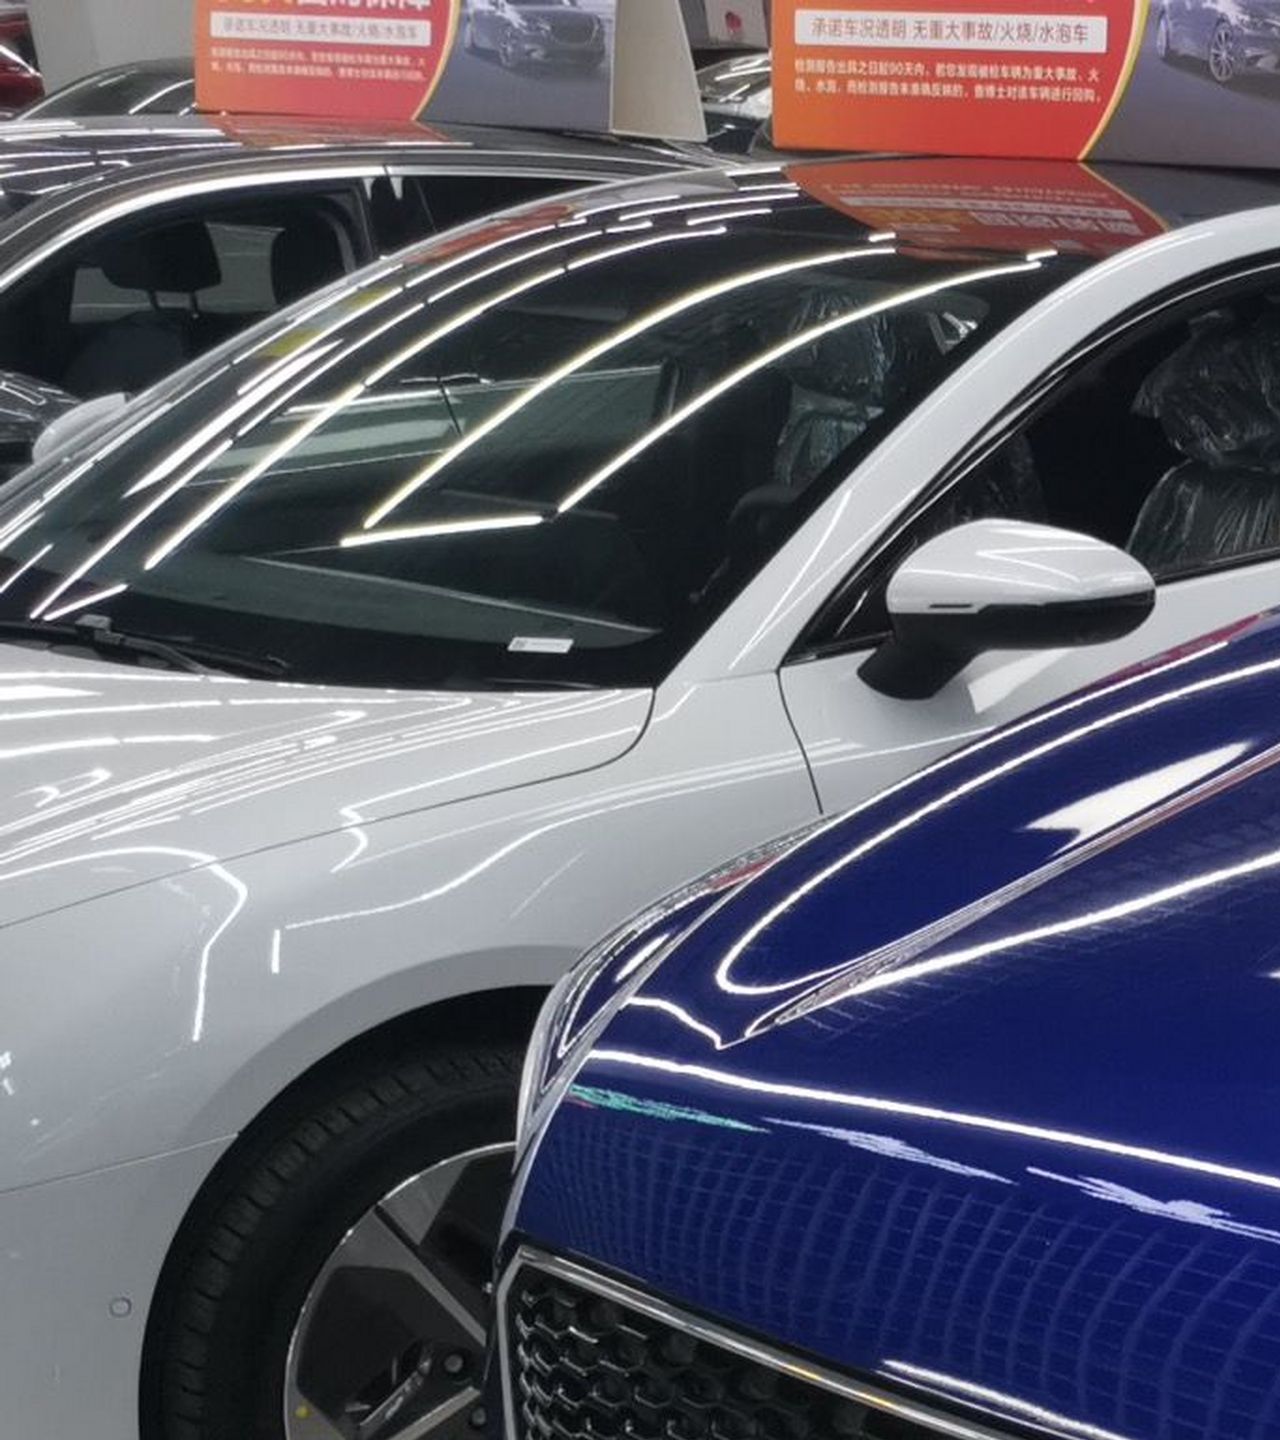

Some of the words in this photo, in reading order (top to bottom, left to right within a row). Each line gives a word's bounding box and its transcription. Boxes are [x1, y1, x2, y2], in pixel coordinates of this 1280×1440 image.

[810, 17, 907, 39] 承诺车况透明
[912, 19, 1090, 44] 无重大事故/火烧/水泡车
